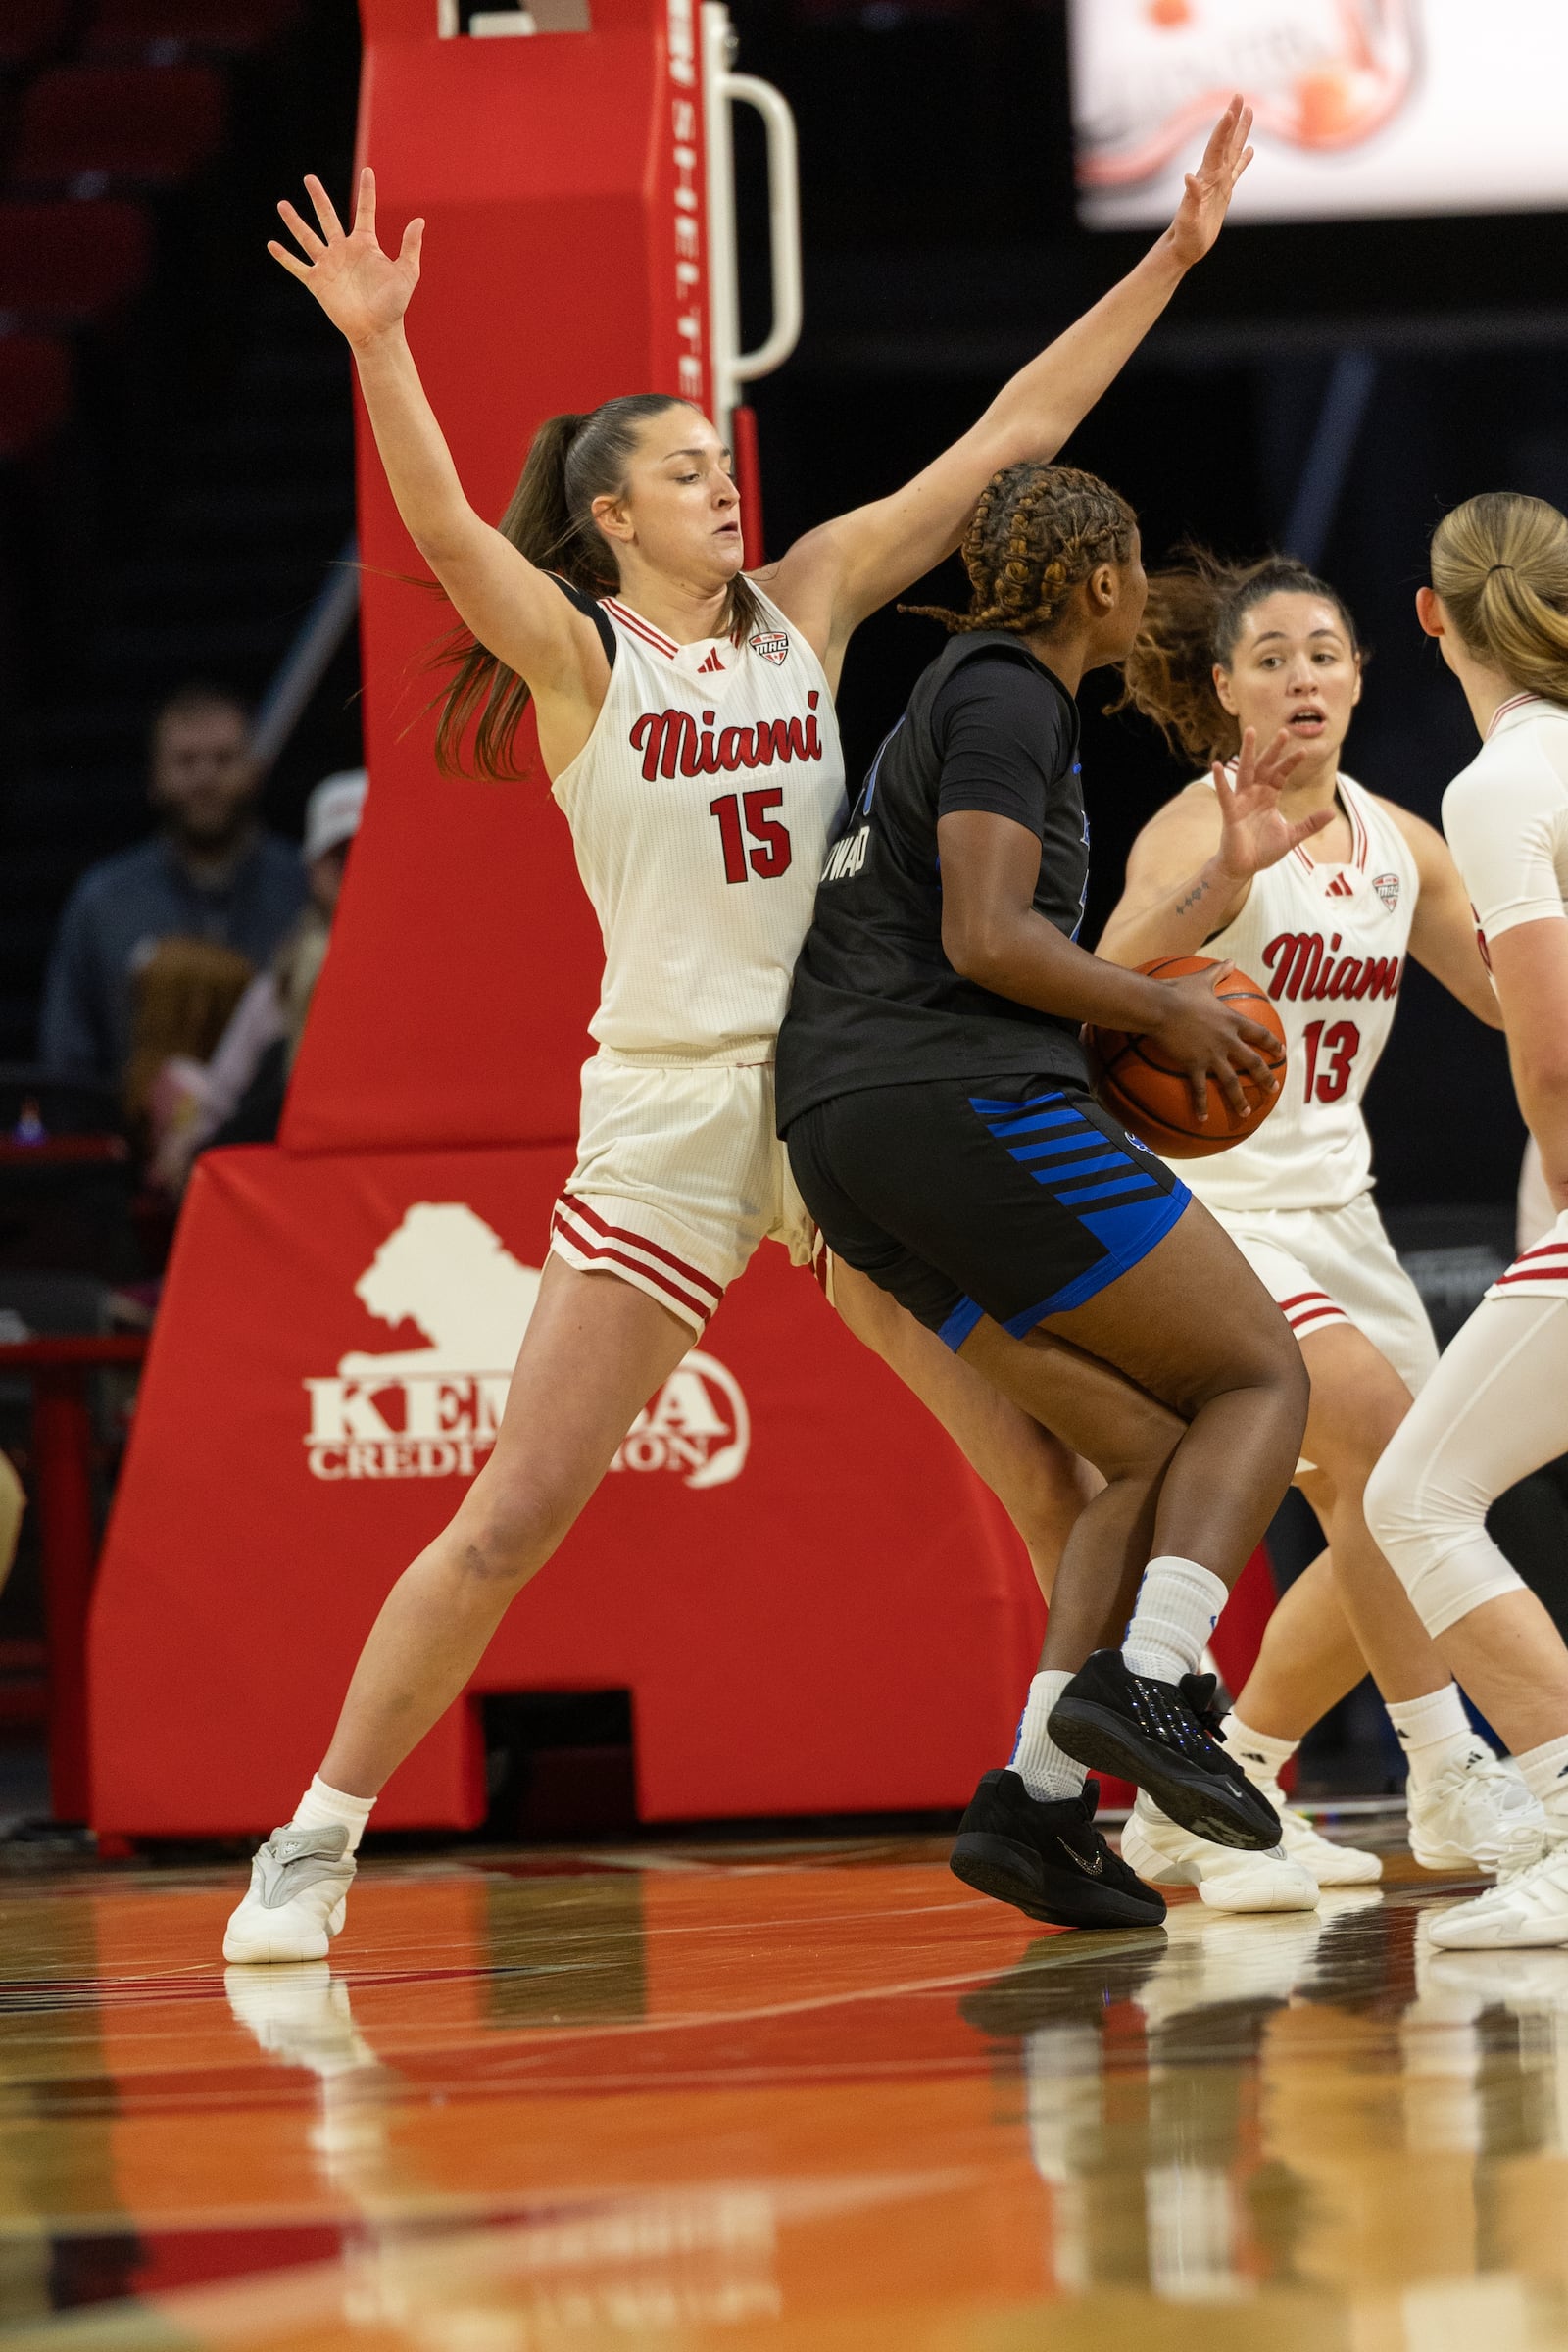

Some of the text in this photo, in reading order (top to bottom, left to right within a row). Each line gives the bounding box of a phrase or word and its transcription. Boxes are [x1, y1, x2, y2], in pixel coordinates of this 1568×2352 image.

[671, 98, 704, 410] SHELTE
[756, 640, 790, 656] MAC
[629, 691, 822, 781] Miami
[710, 787, 792, 884] 15
[1302, 1020, 1360, 1104] 13
[308, 1441, 496, 1481] CREDI
